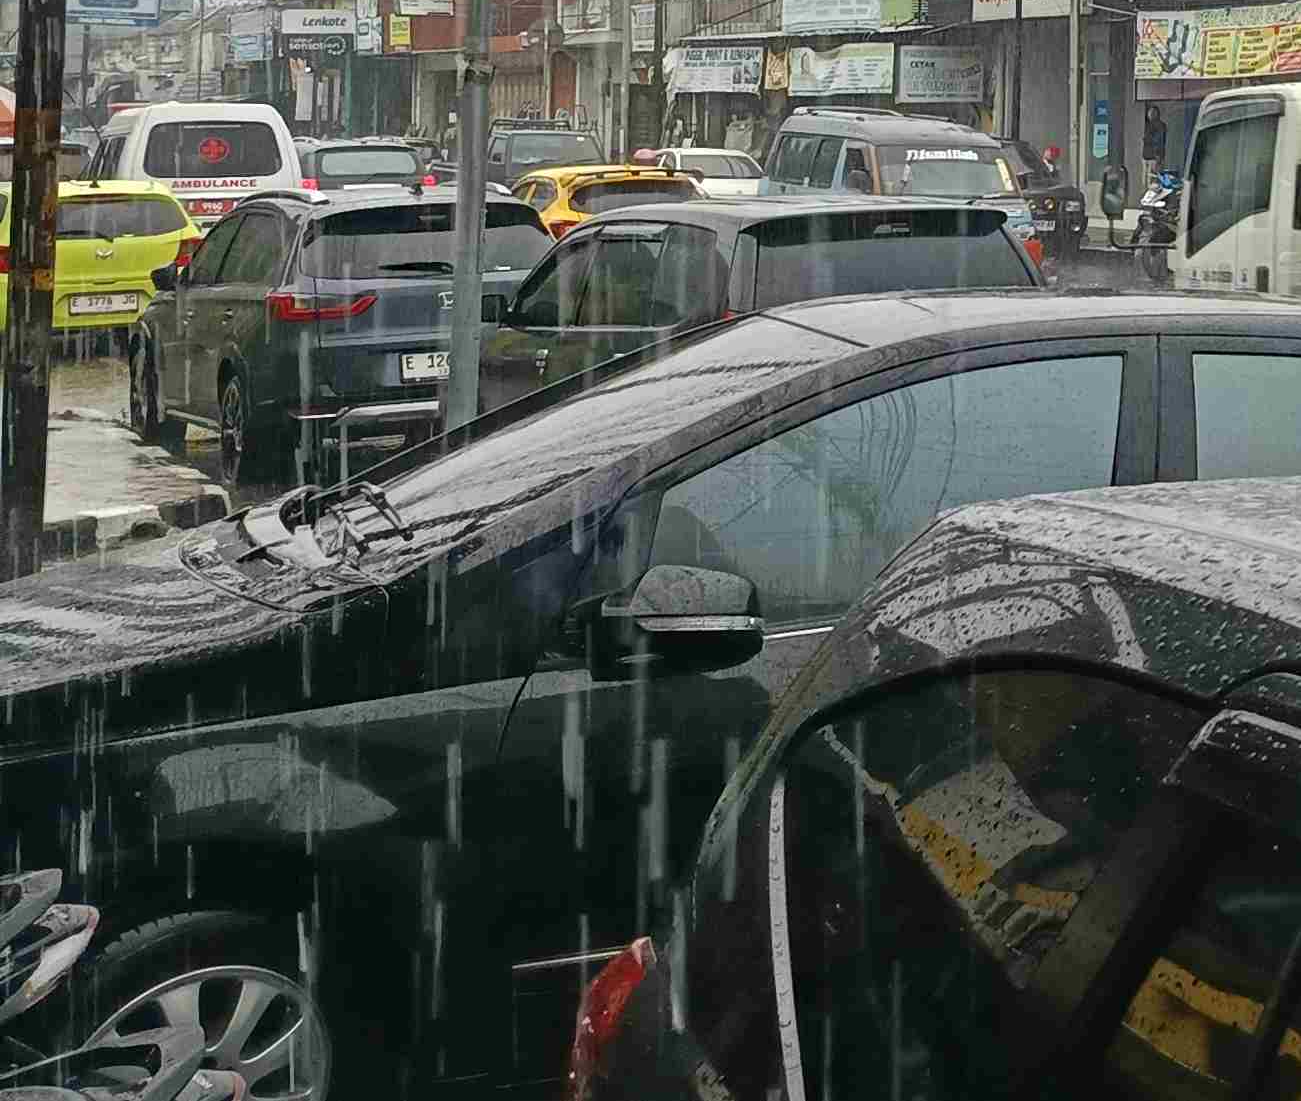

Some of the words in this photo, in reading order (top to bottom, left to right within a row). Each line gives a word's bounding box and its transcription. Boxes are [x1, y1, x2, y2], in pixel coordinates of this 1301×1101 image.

[171, 179, 257, 189] AMBULANCE
[405, 356, 415, 370] E
[427, 355, 450, 369] 12
